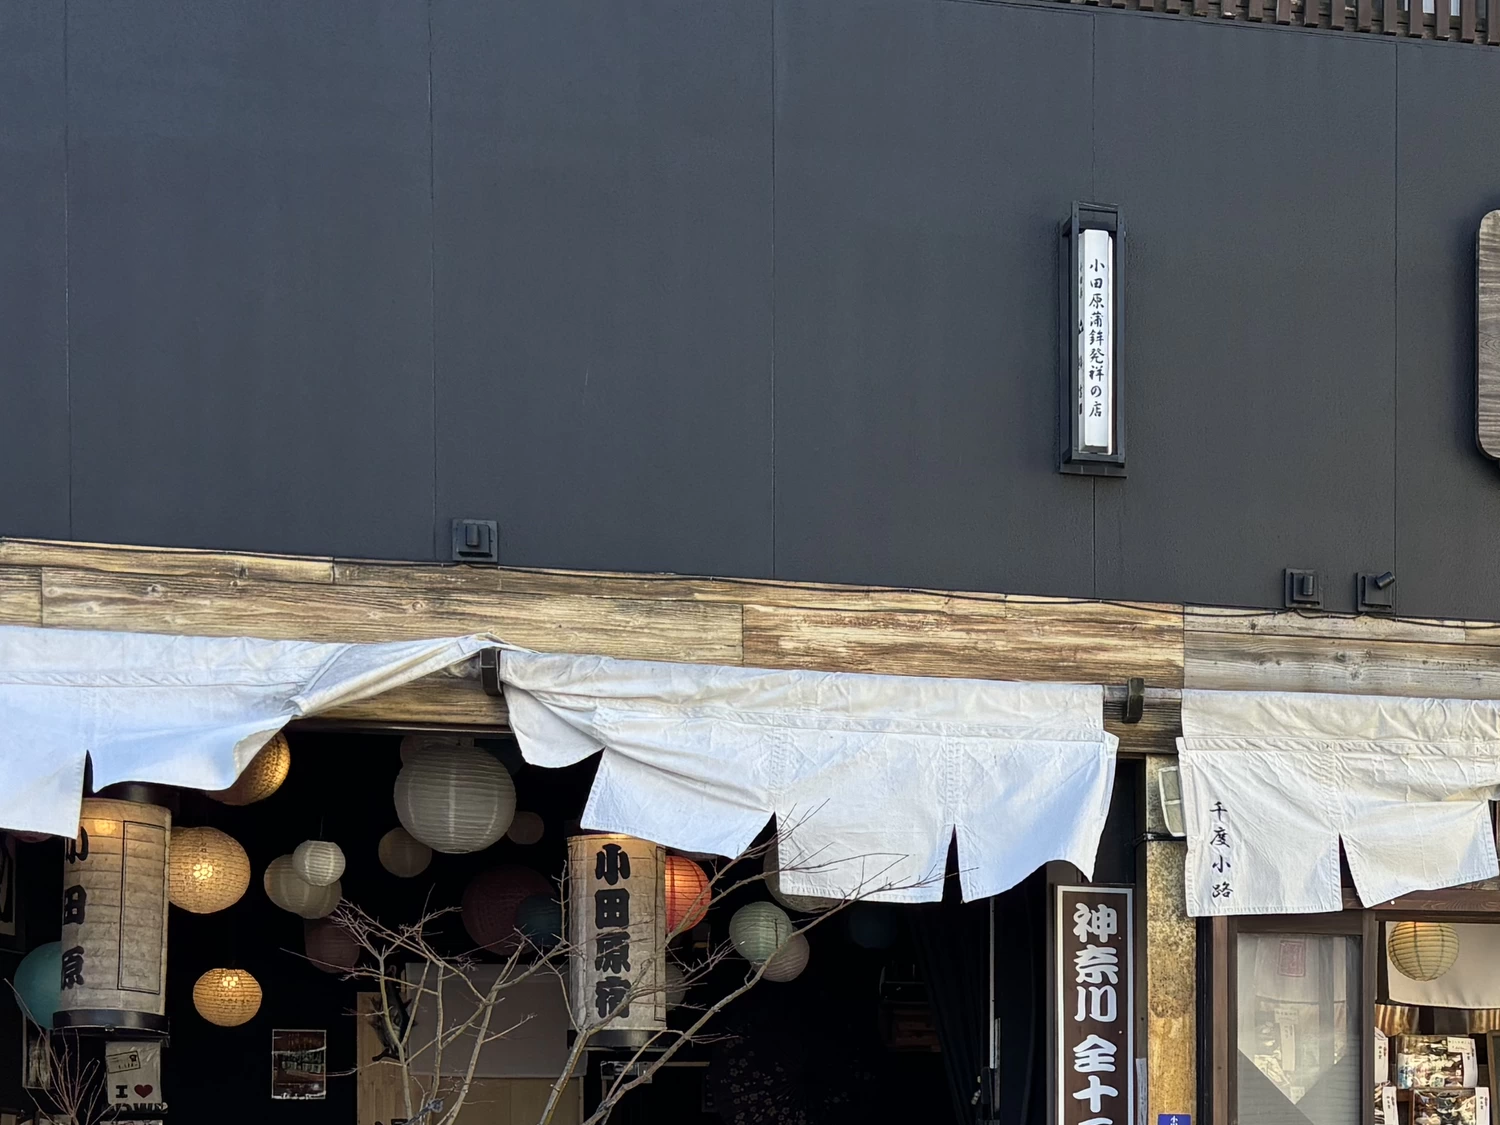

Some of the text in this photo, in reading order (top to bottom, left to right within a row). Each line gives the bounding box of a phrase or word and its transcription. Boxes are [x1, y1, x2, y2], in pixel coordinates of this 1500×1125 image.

[1088, 258, 1105, 418] 小田原蒲鉾発祥の店
[1209, 801, 1234, 898] 千度小路
[595, 843, 631, 1018] 小田原宿
